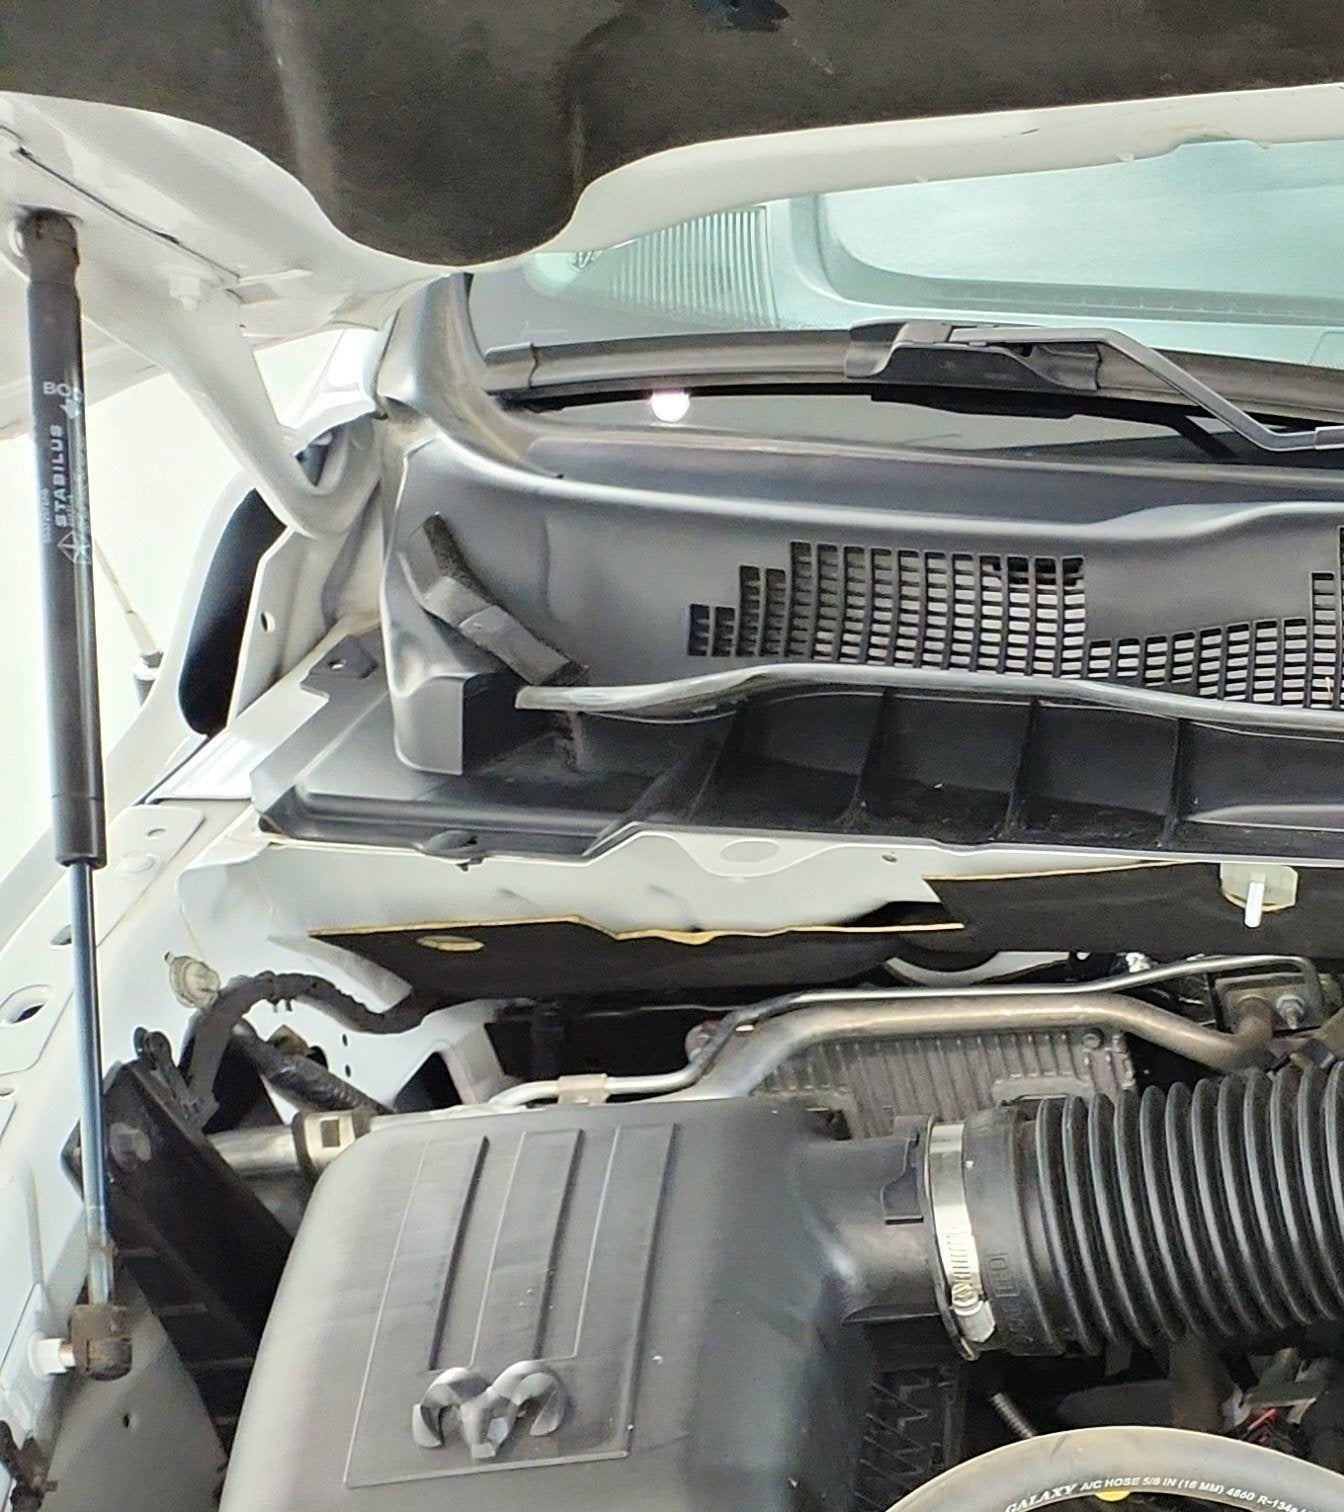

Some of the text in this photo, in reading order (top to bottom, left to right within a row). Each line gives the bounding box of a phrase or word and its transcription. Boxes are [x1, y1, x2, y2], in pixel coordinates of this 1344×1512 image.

[50, 423, 69, 528] STABILUS
[1080, 1479, 1103, 1491] A/C
[1105, 1476, 1140, 1488] HOSE
[1142, 1477, 1161, 1486] 5/8
[1163, 1477, 1177, 1487] IN
[1178, 1478, 1197, 1489] (16
[1198, 1482, 1225, 1495] MM)
